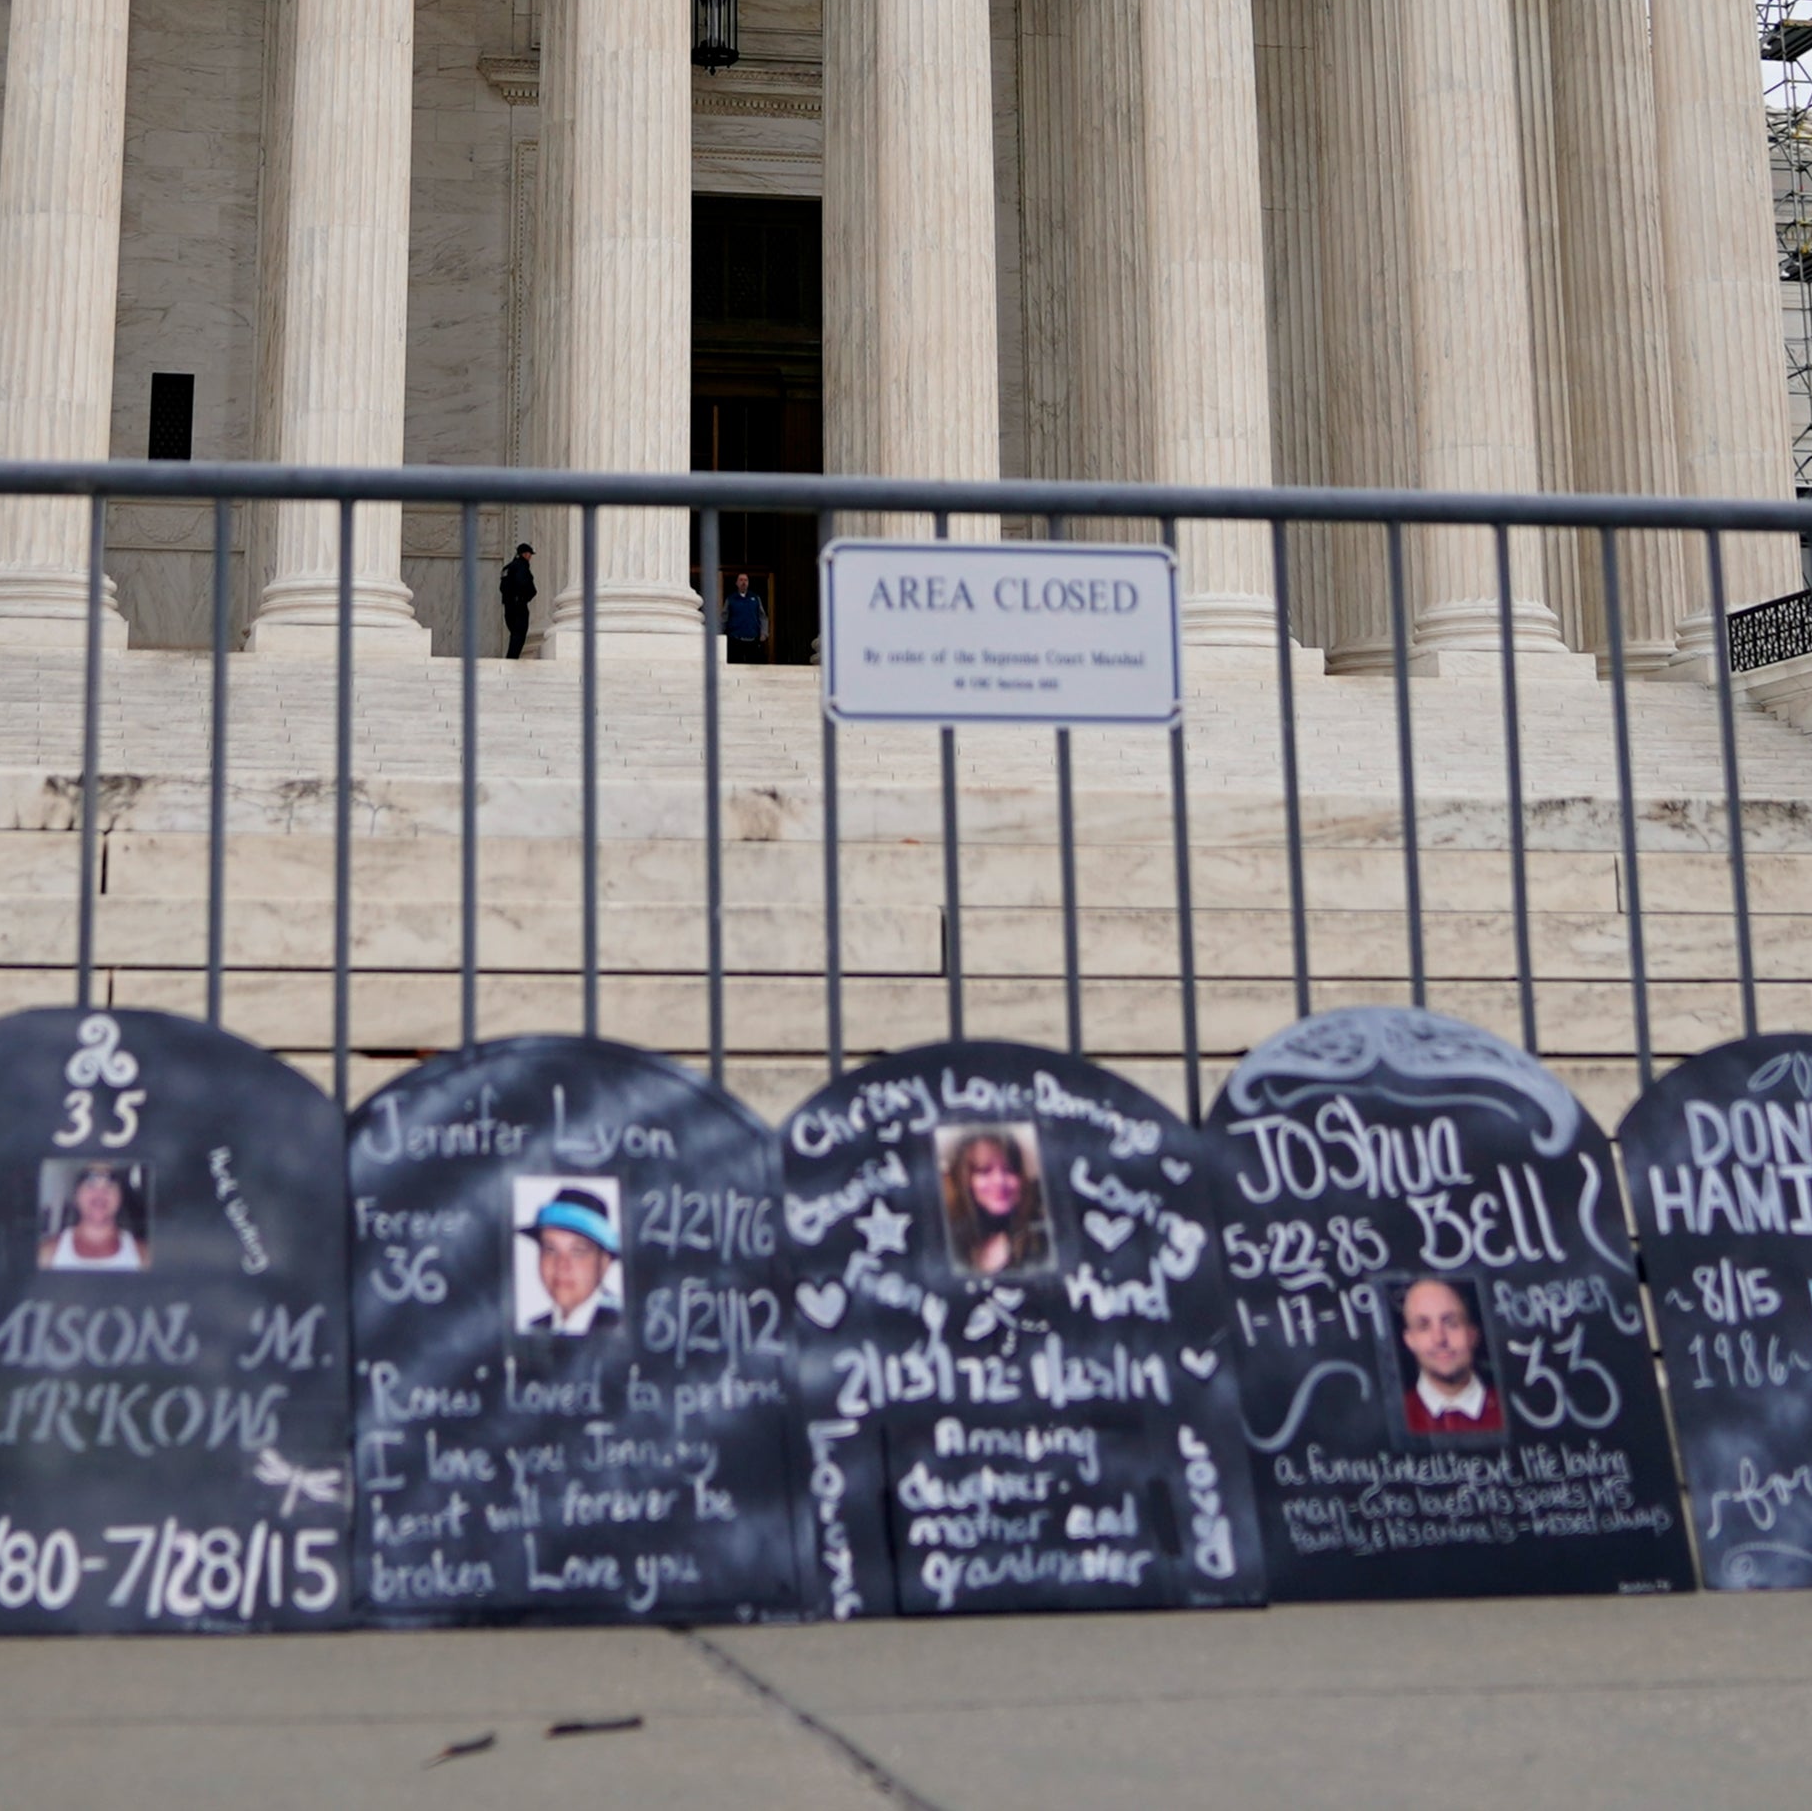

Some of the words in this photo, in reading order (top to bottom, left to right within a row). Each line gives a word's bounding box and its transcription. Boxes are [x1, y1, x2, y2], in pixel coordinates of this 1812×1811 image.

[868, 576, 975, 611] AREA
[994, 577, 1140, 614] CLOSED
[932, 648, 947, 664] of
[954, 648, 975, 665] the
[982, 649, 1039, 668] Supreme
[1046, 649, 1084, 666] Court
[1091, 650, 1145, 667] Marshal
[53, 1090, 146, 1149] 35
[358, 1084, 531, 1165] Jennifer
[553, 1084, 678, 1168] Lyon
[354, 1196, 471, 1240] Forever
[370, 1244, 448, 1304] 36
[1065, 1256, 1171, 1321] Kind
[236, 1303, 335, 1371] M.
[1507, 1324, 1619, 1428] 33
[361, 1430, 406, 1491] I
[426, 1429, 496, 1481] love
[506, 1443, 565, 1497] you
[933, 1417, 1100, 1485] Amazing
[372, 1492, 469, 1546] heart
[486, 1486, 540, 1531] will
[563, 1479, 679, 1527] forever
[695, 1476, 737, 1521] be
[908, 1508, 1050, 1550] mother
[524, 1532, 622, 1591] Love
[627, 1553, 700, 1613] you
